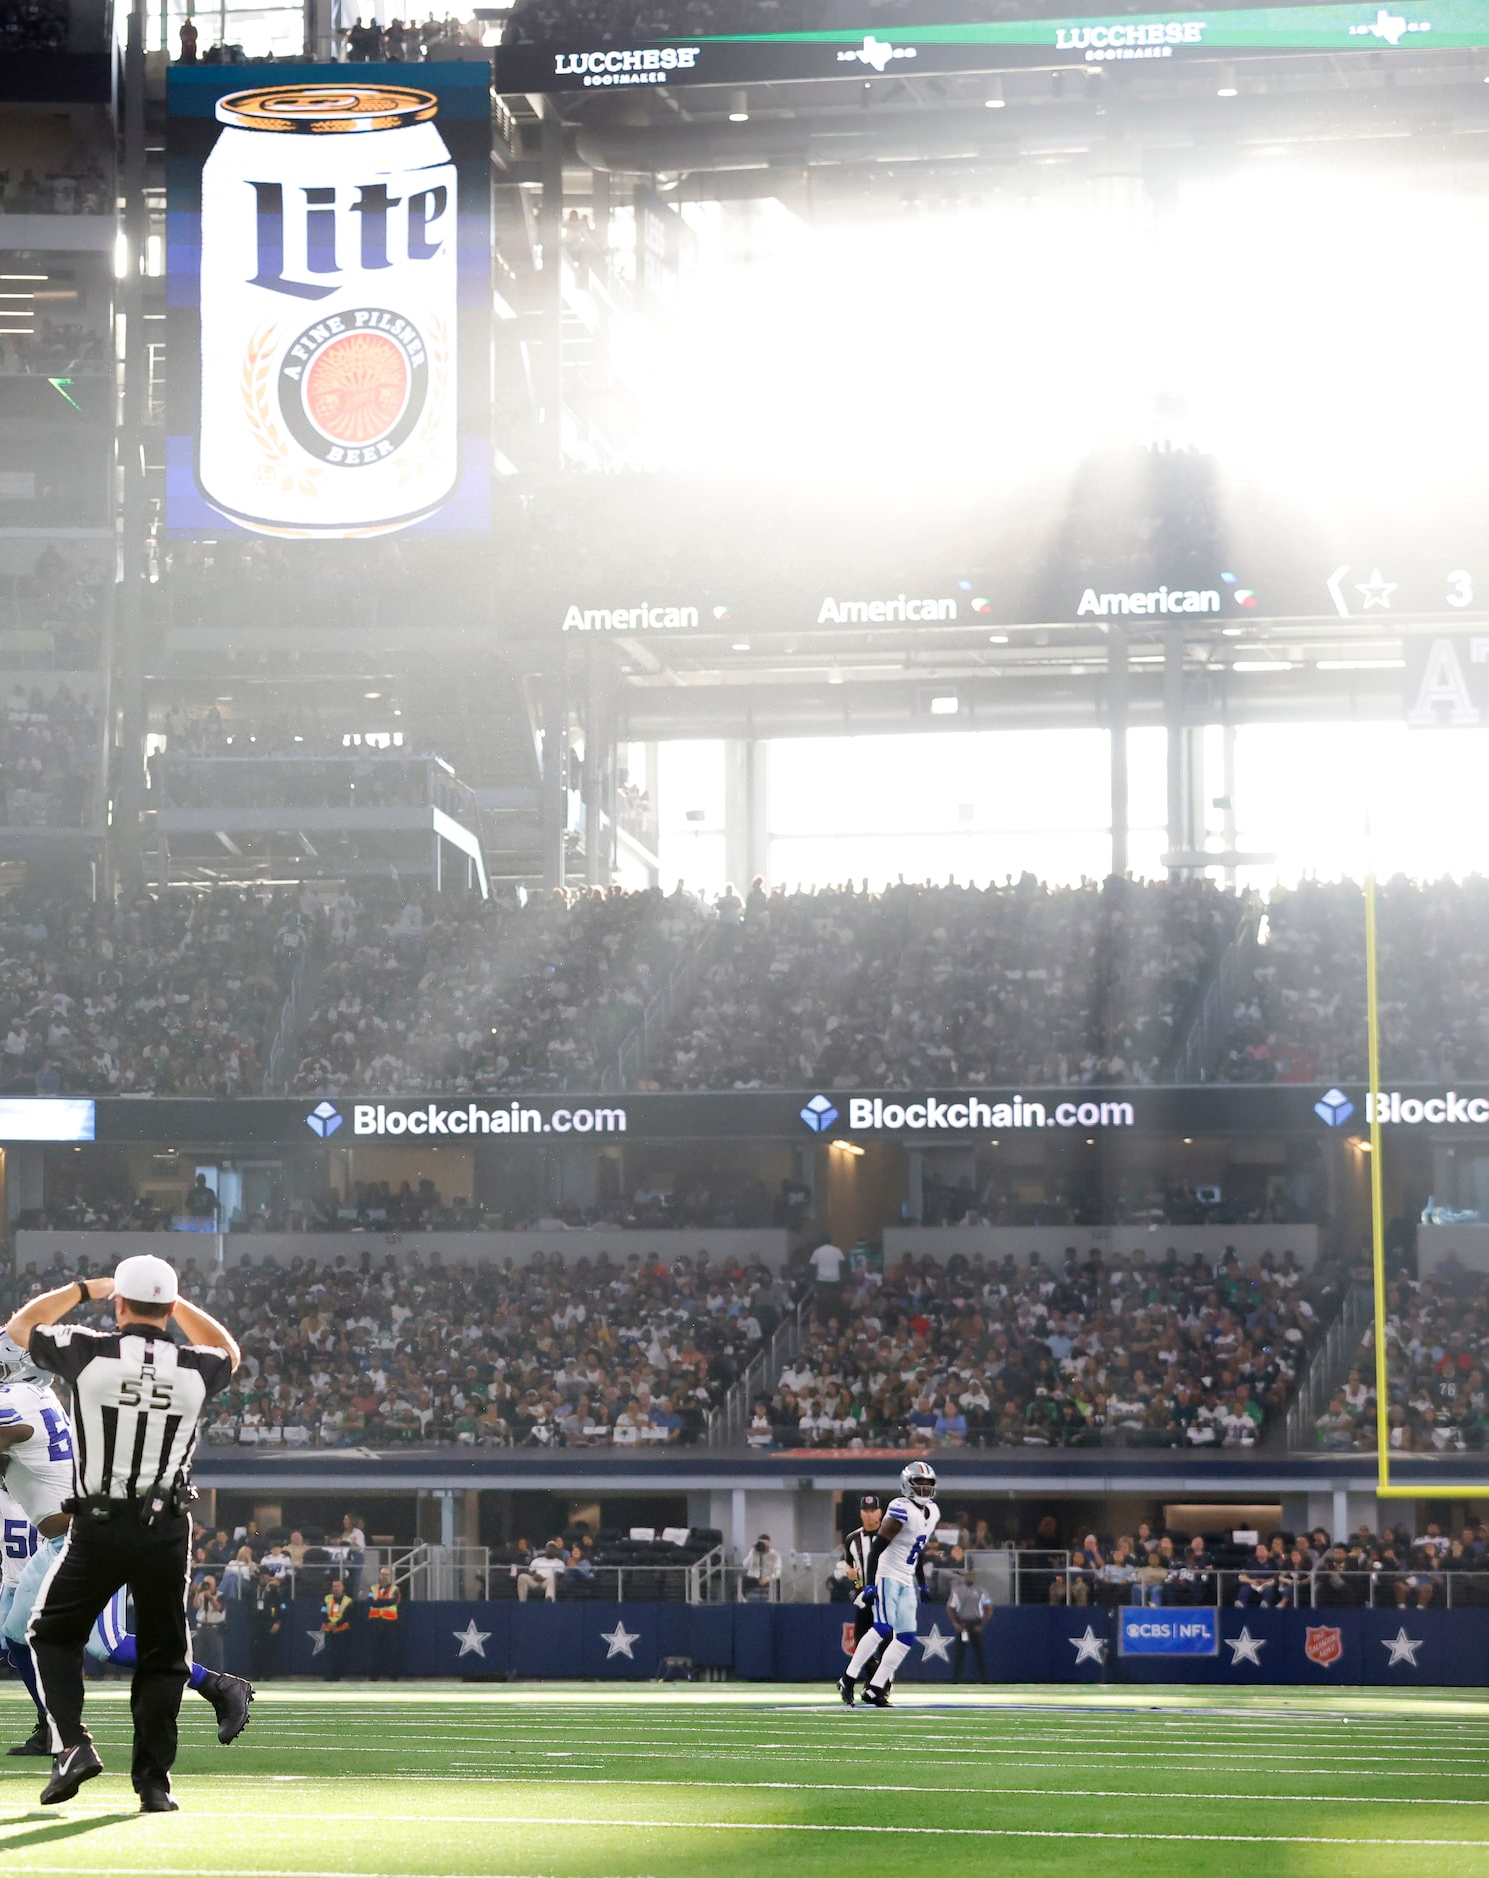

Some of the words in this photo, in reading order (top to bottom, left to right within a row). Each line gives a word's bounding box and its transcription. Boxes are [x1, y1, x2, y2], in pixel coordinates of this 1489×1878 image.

[1054, 22, 1204, 50] LUCCHESE
[554, 47, 698, 75] LUCCHESE
[242, 179, 449, 301] Lite
[290, 316, 347, 361] FINE
[353, 310, 426, 369] PILSNER
[282, 365, 303, 382] A
[325, 439, 395, 465] BEER
[1076, 585, 1221, 616] American
[1445, 569, 1474, 608] 3
[561, 602, 699, 632] American
[817, 594, 958, 624] American
[353, 1101, 627, 1135] Blockchain.com
[849, 1094, 1135, 1129] Blockchain.com
[139, 1365, 156, 1381] R
[118, 1380, 174, 1411] 55
[1140, 1623, 1171, 1638] CBS
[1179, 1623, 1211, 1638] NFL
